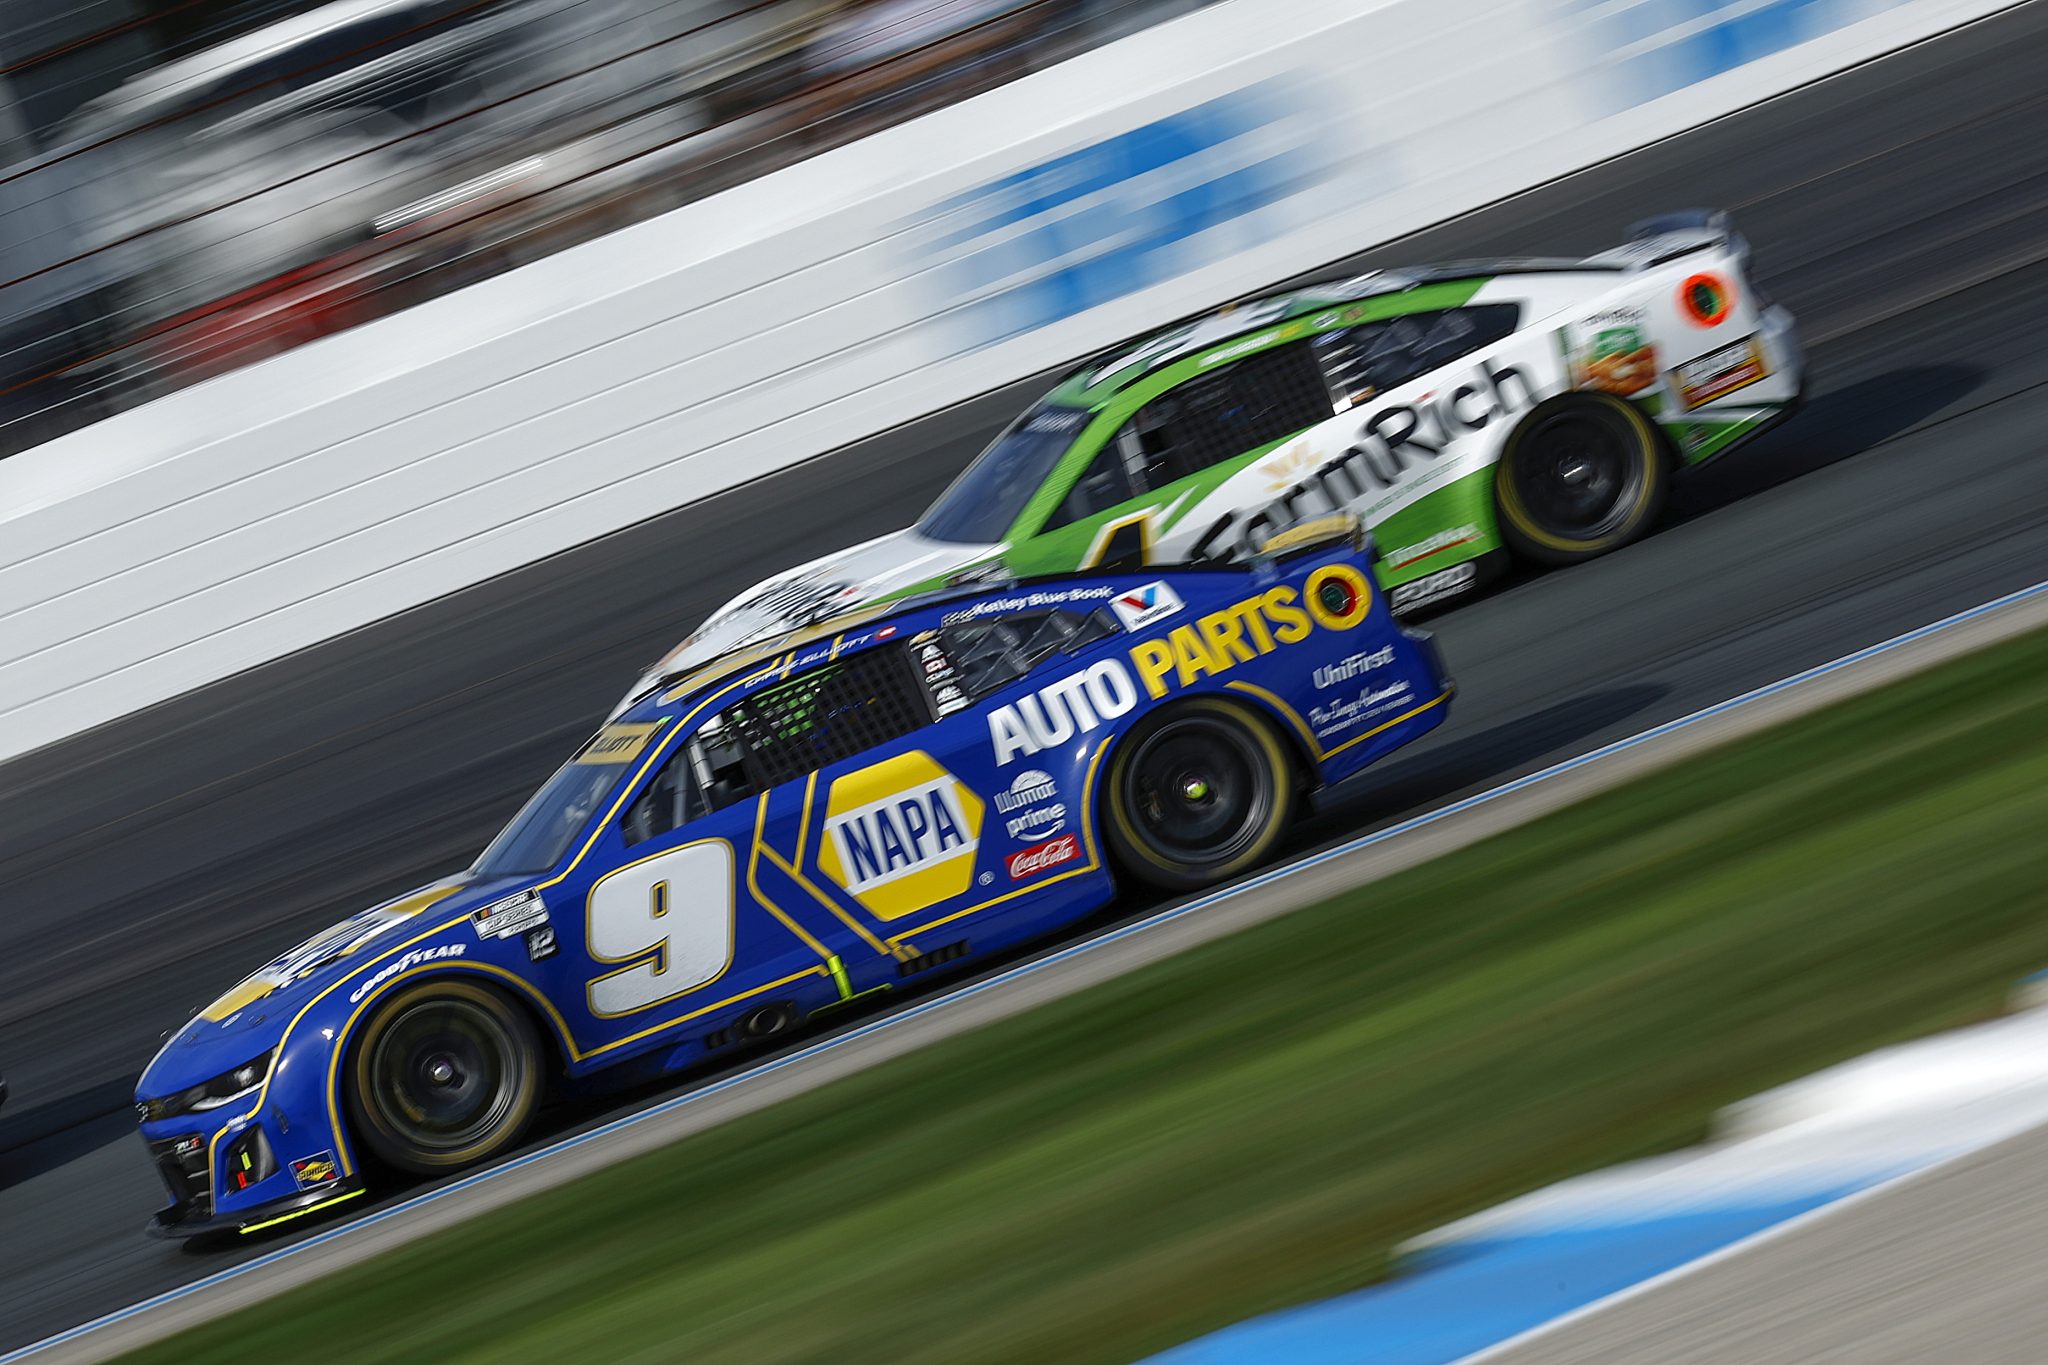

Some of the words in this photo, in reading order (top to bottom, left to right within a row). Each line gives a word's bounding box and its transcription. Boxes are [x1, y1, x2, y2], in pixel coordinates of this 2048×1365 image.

[973, 597, 1026, 616] Kelley
[1029, 592, 1066, 607] Blue
[1069, 586, 1114, 602] Book
[1129, 585, 1314, 700] PARTS
[1313, 643, 1397, 690] UniFirst
[986, 658, 1137, 768] AUTO
[839, 789, 967, 885] NAPA
[1006, 802, 1067, 839] prime
[586, 837, 735, 1020] 9
[349, 943, 467, 1003] GOODYEAR
